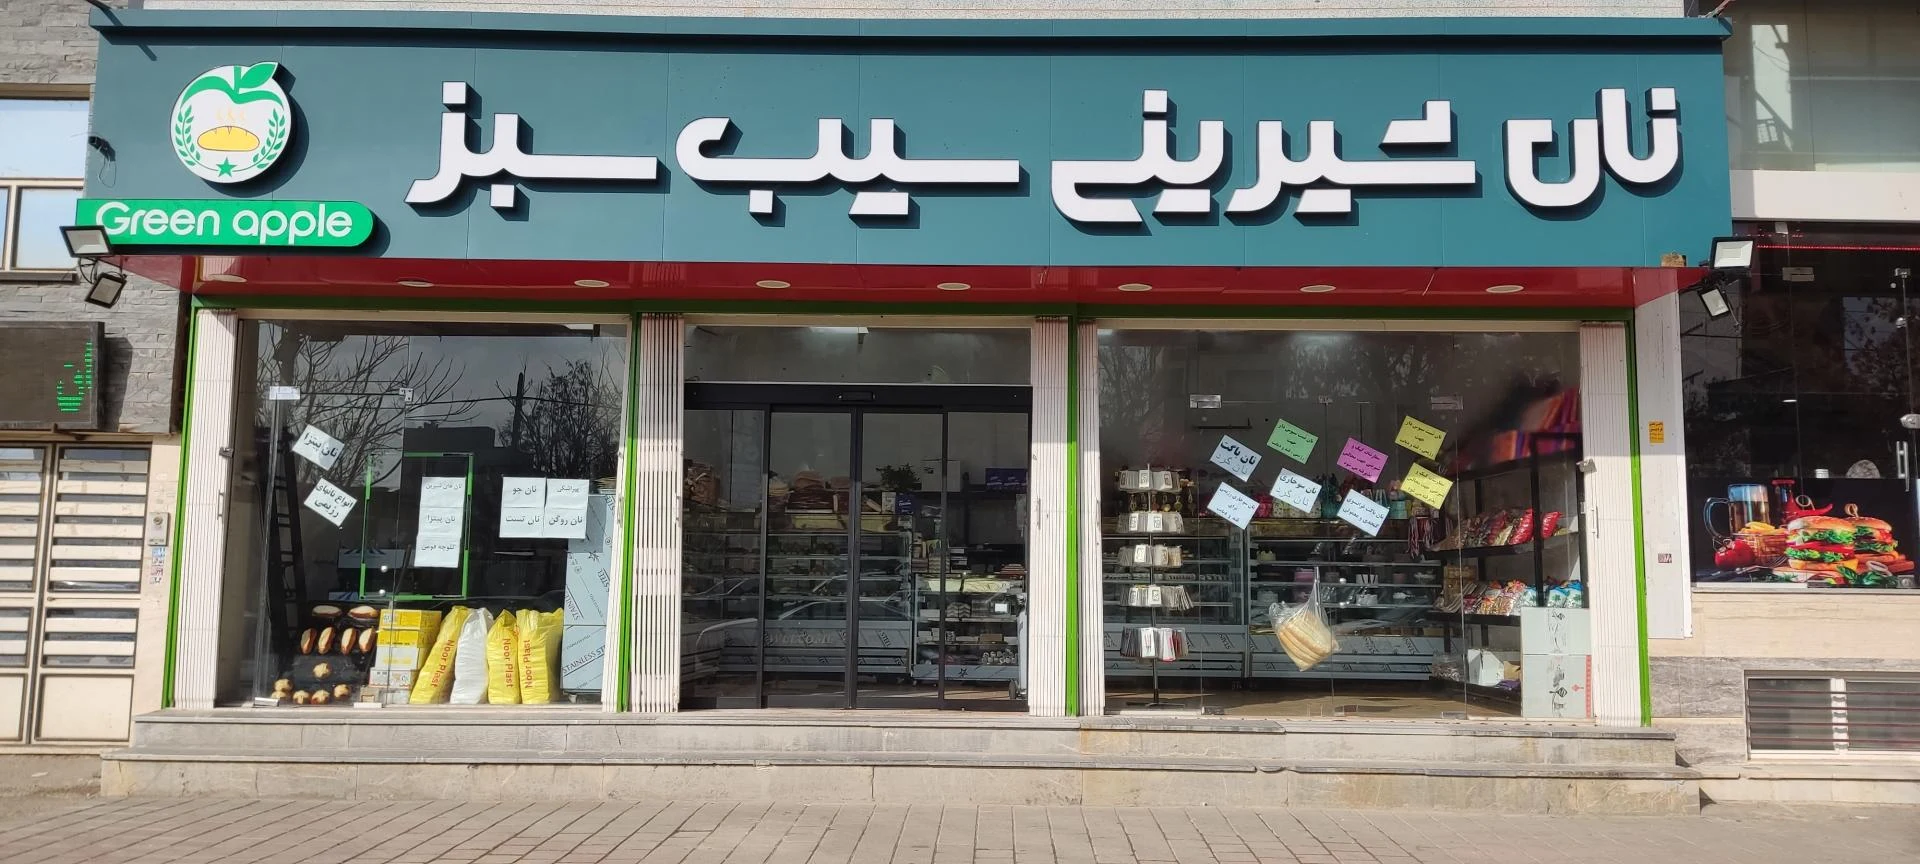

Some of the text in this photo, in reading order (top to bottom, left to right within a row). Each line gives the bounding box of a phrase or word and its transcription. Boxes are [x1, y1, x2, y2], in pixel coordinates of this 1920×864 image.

[404, 81, 1678, 222] نان شیرینی سیب سبز
[96, 202, 353, 245] Green apple
[304, 432, 338, 458] نان پیتزا
[1240, 455, 1257, 465] نان
[1232, 464, 1248, 475] نان
[316, 484, 354, 509] انواع نانهای
[512, 485, 537, 495] نان جو
[1305, 487, 1317, 495] نان
[314, 499, 340, 518] رژیمی
[1293, 496, 1309, 506] نان
[445, 515, 456, 524] نان
[527, 515, 540, 525] نان
[570, 515, 583, 526] نان
[431, 640, 455, 687] Noor Plast
[503, 638, 514, 688] Noor Plast
[522, 639, 533, 688] Noor Plast
